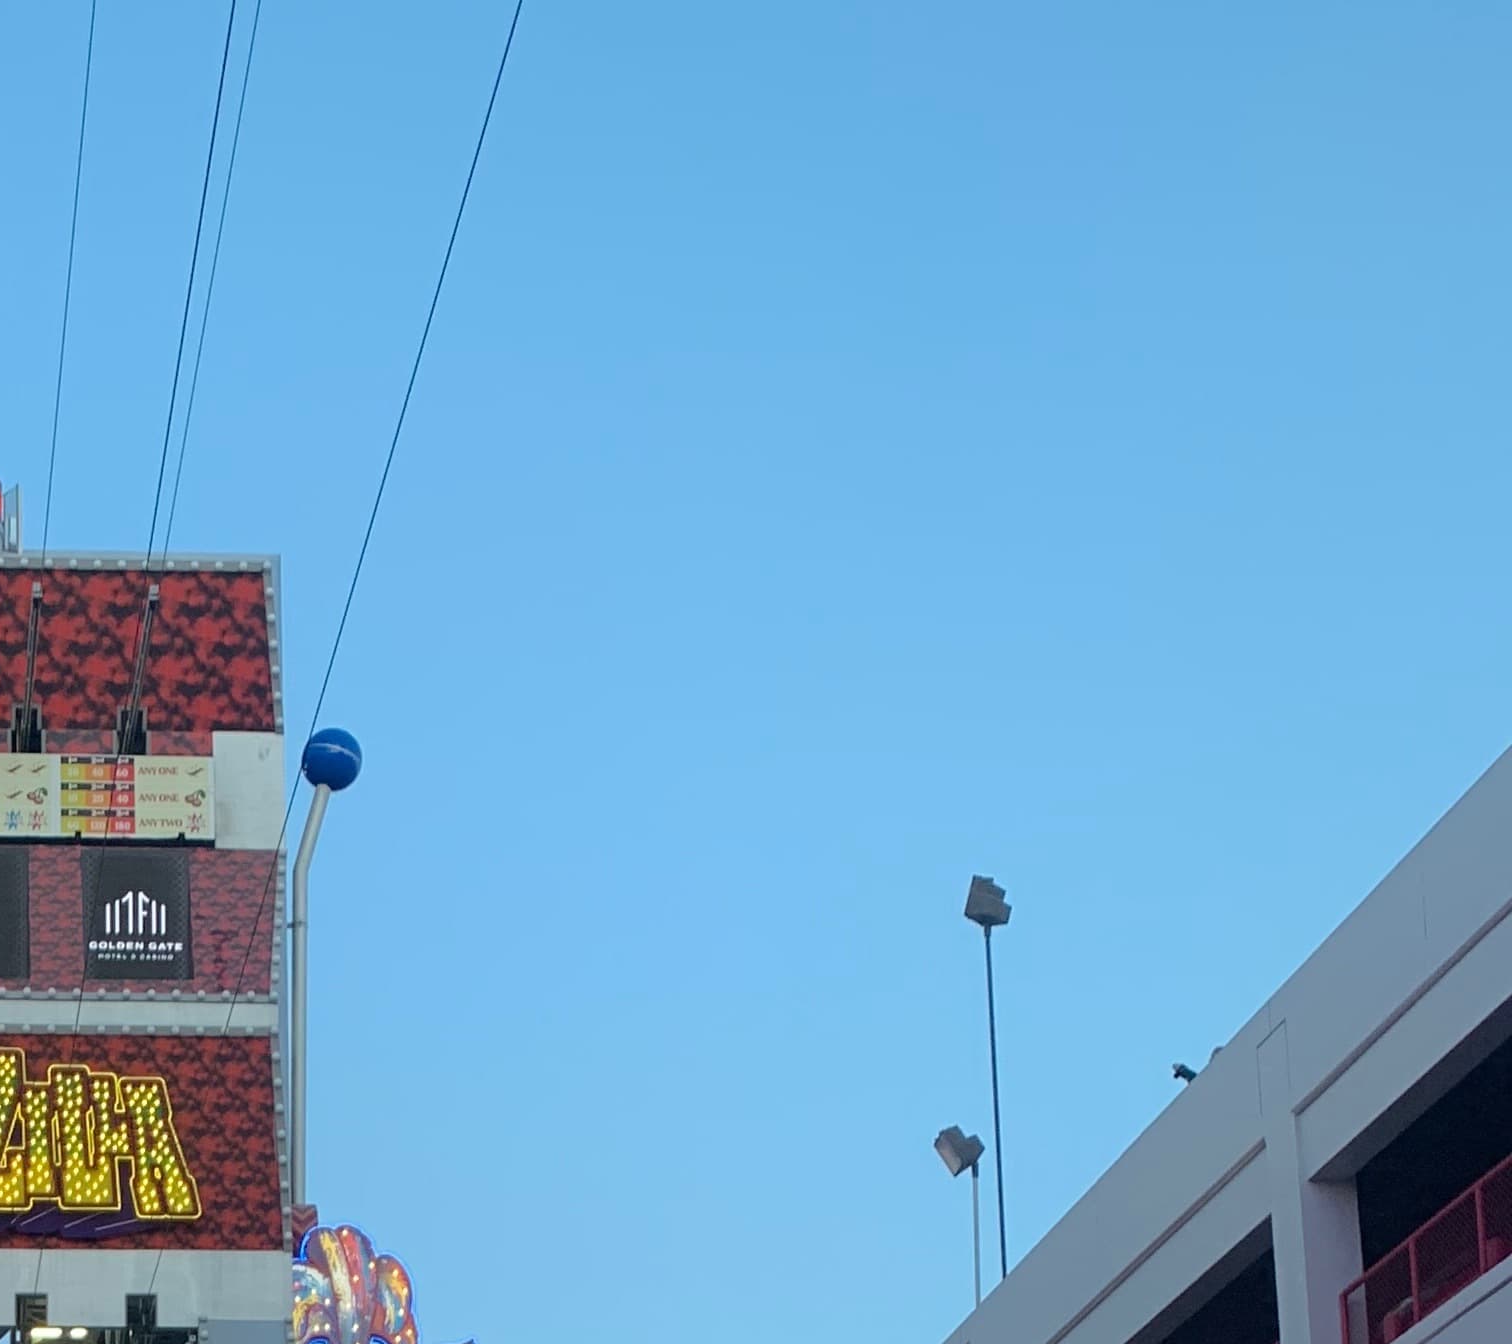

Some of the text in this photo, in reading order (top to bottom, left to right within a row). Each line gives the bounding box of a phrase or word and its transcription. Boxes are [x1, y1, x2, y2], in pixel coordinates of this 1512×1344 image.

[138, 766, 178, 776] ANY ONE
[138, 793, 179, 803] ANY ONE
[138, 818, 184, 828] ANY TWO
[88, 940, 184, 952] GOLDEN GATE
